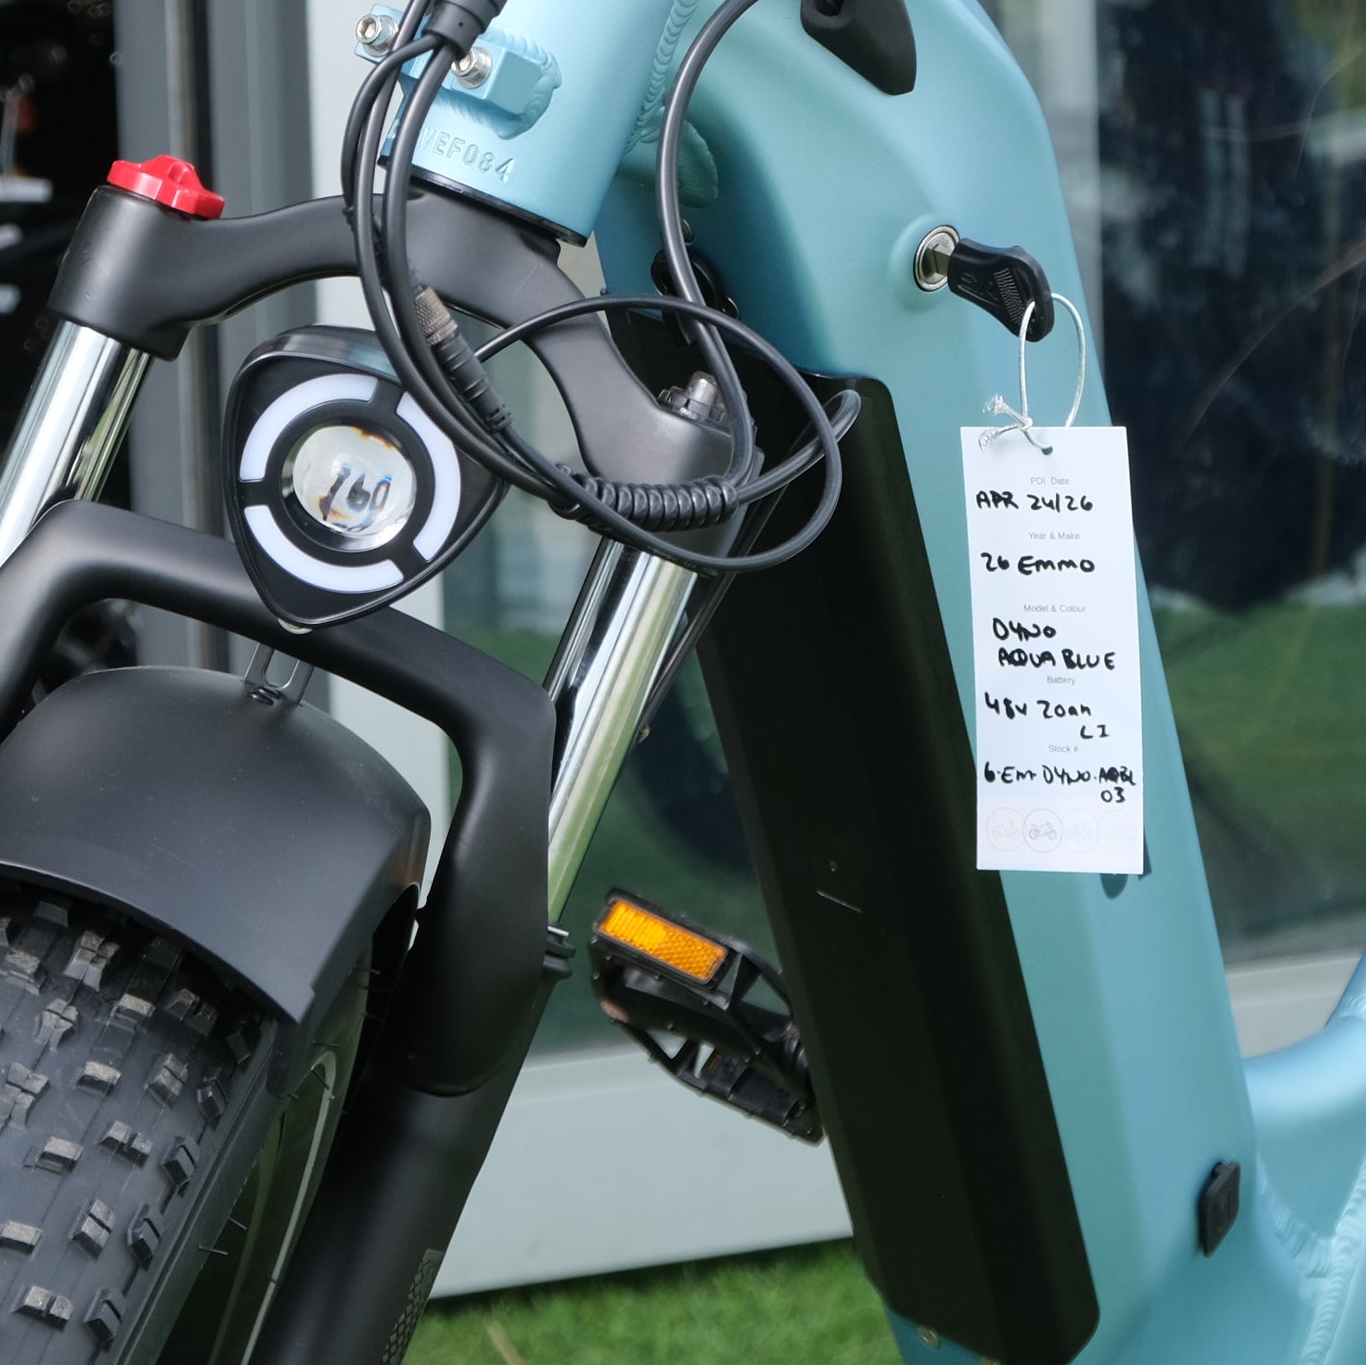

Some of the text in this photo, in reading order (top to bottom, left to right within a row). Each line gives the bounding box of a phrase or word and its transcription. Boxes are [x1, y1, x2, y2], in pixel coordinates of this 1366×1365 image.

[1030, 476, 1070, 485] PDI Date
[976, 490, 1019, 509] APR
[1028, 531, 1047, 540] Year
[1058, 531, 1080, 540] Make
[980, 552, 1010, 572] 26
[1023, 604, 1049, 613] Model
[1059, 604, 1086, 613] Colour
[998, 647, 1116, 671] AQUA BLUE
[1046, 675, 1076, 686] Battery
[1048, 744, 1071, 753] Stock
